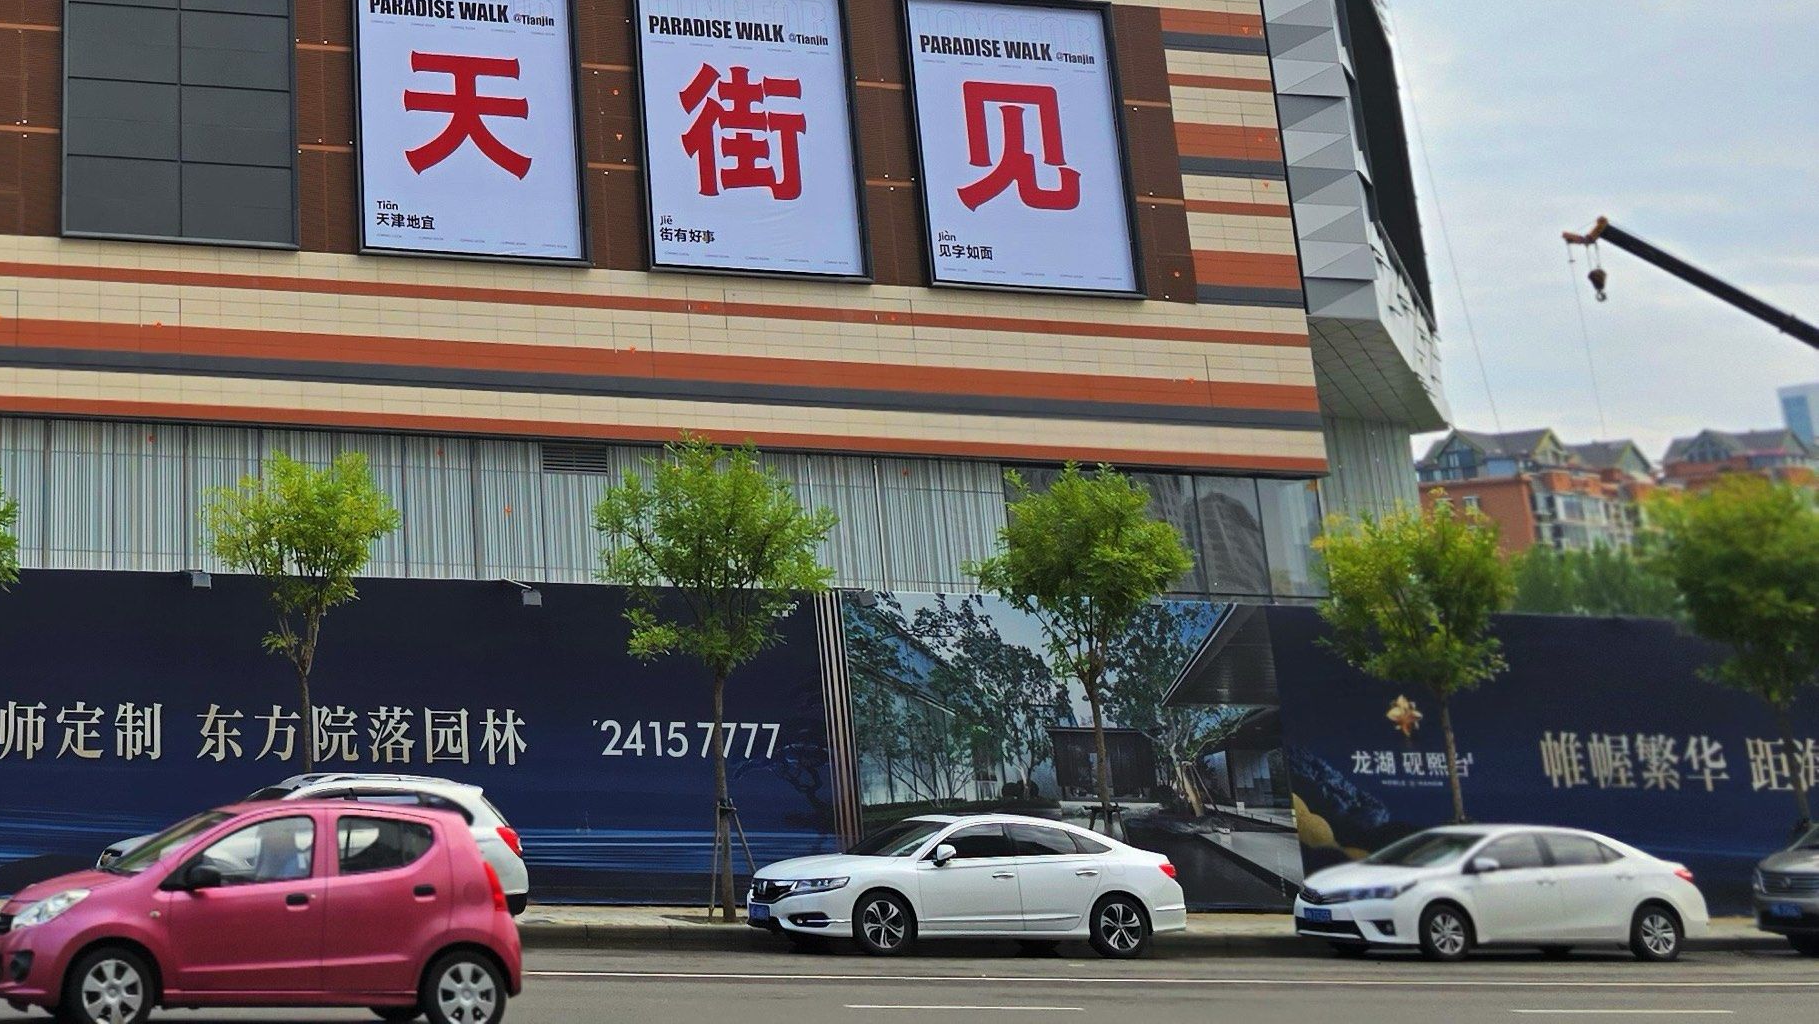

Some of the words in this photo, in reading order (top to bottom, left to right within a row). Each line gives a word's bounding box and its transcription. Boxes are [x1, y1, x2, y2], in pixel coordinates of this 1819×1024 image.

[459, 1, 509, 23] WALK
[648, 15, 732, 39] PARADISE
[735, 22, 785, 43] WALK
[919, 34, 1001, 58] PARADISE
[1004, 41, 1052, 61] WALK
[403, 50, 532, 181] 天
[679, 62, 808, 201] 街
[957, 80, 1081, 212] 见
[376, 212, 435, 230] 天津地宜
[659, 227, 715, 244] 街有好事
[938, 244, 993, 260] 见字如面
[196, 703, 527, 765] 东方院落园林
[1351, 750, 1396, 775] 龙湖
[1540, 731, 1730, 792] 帷幄繁华
